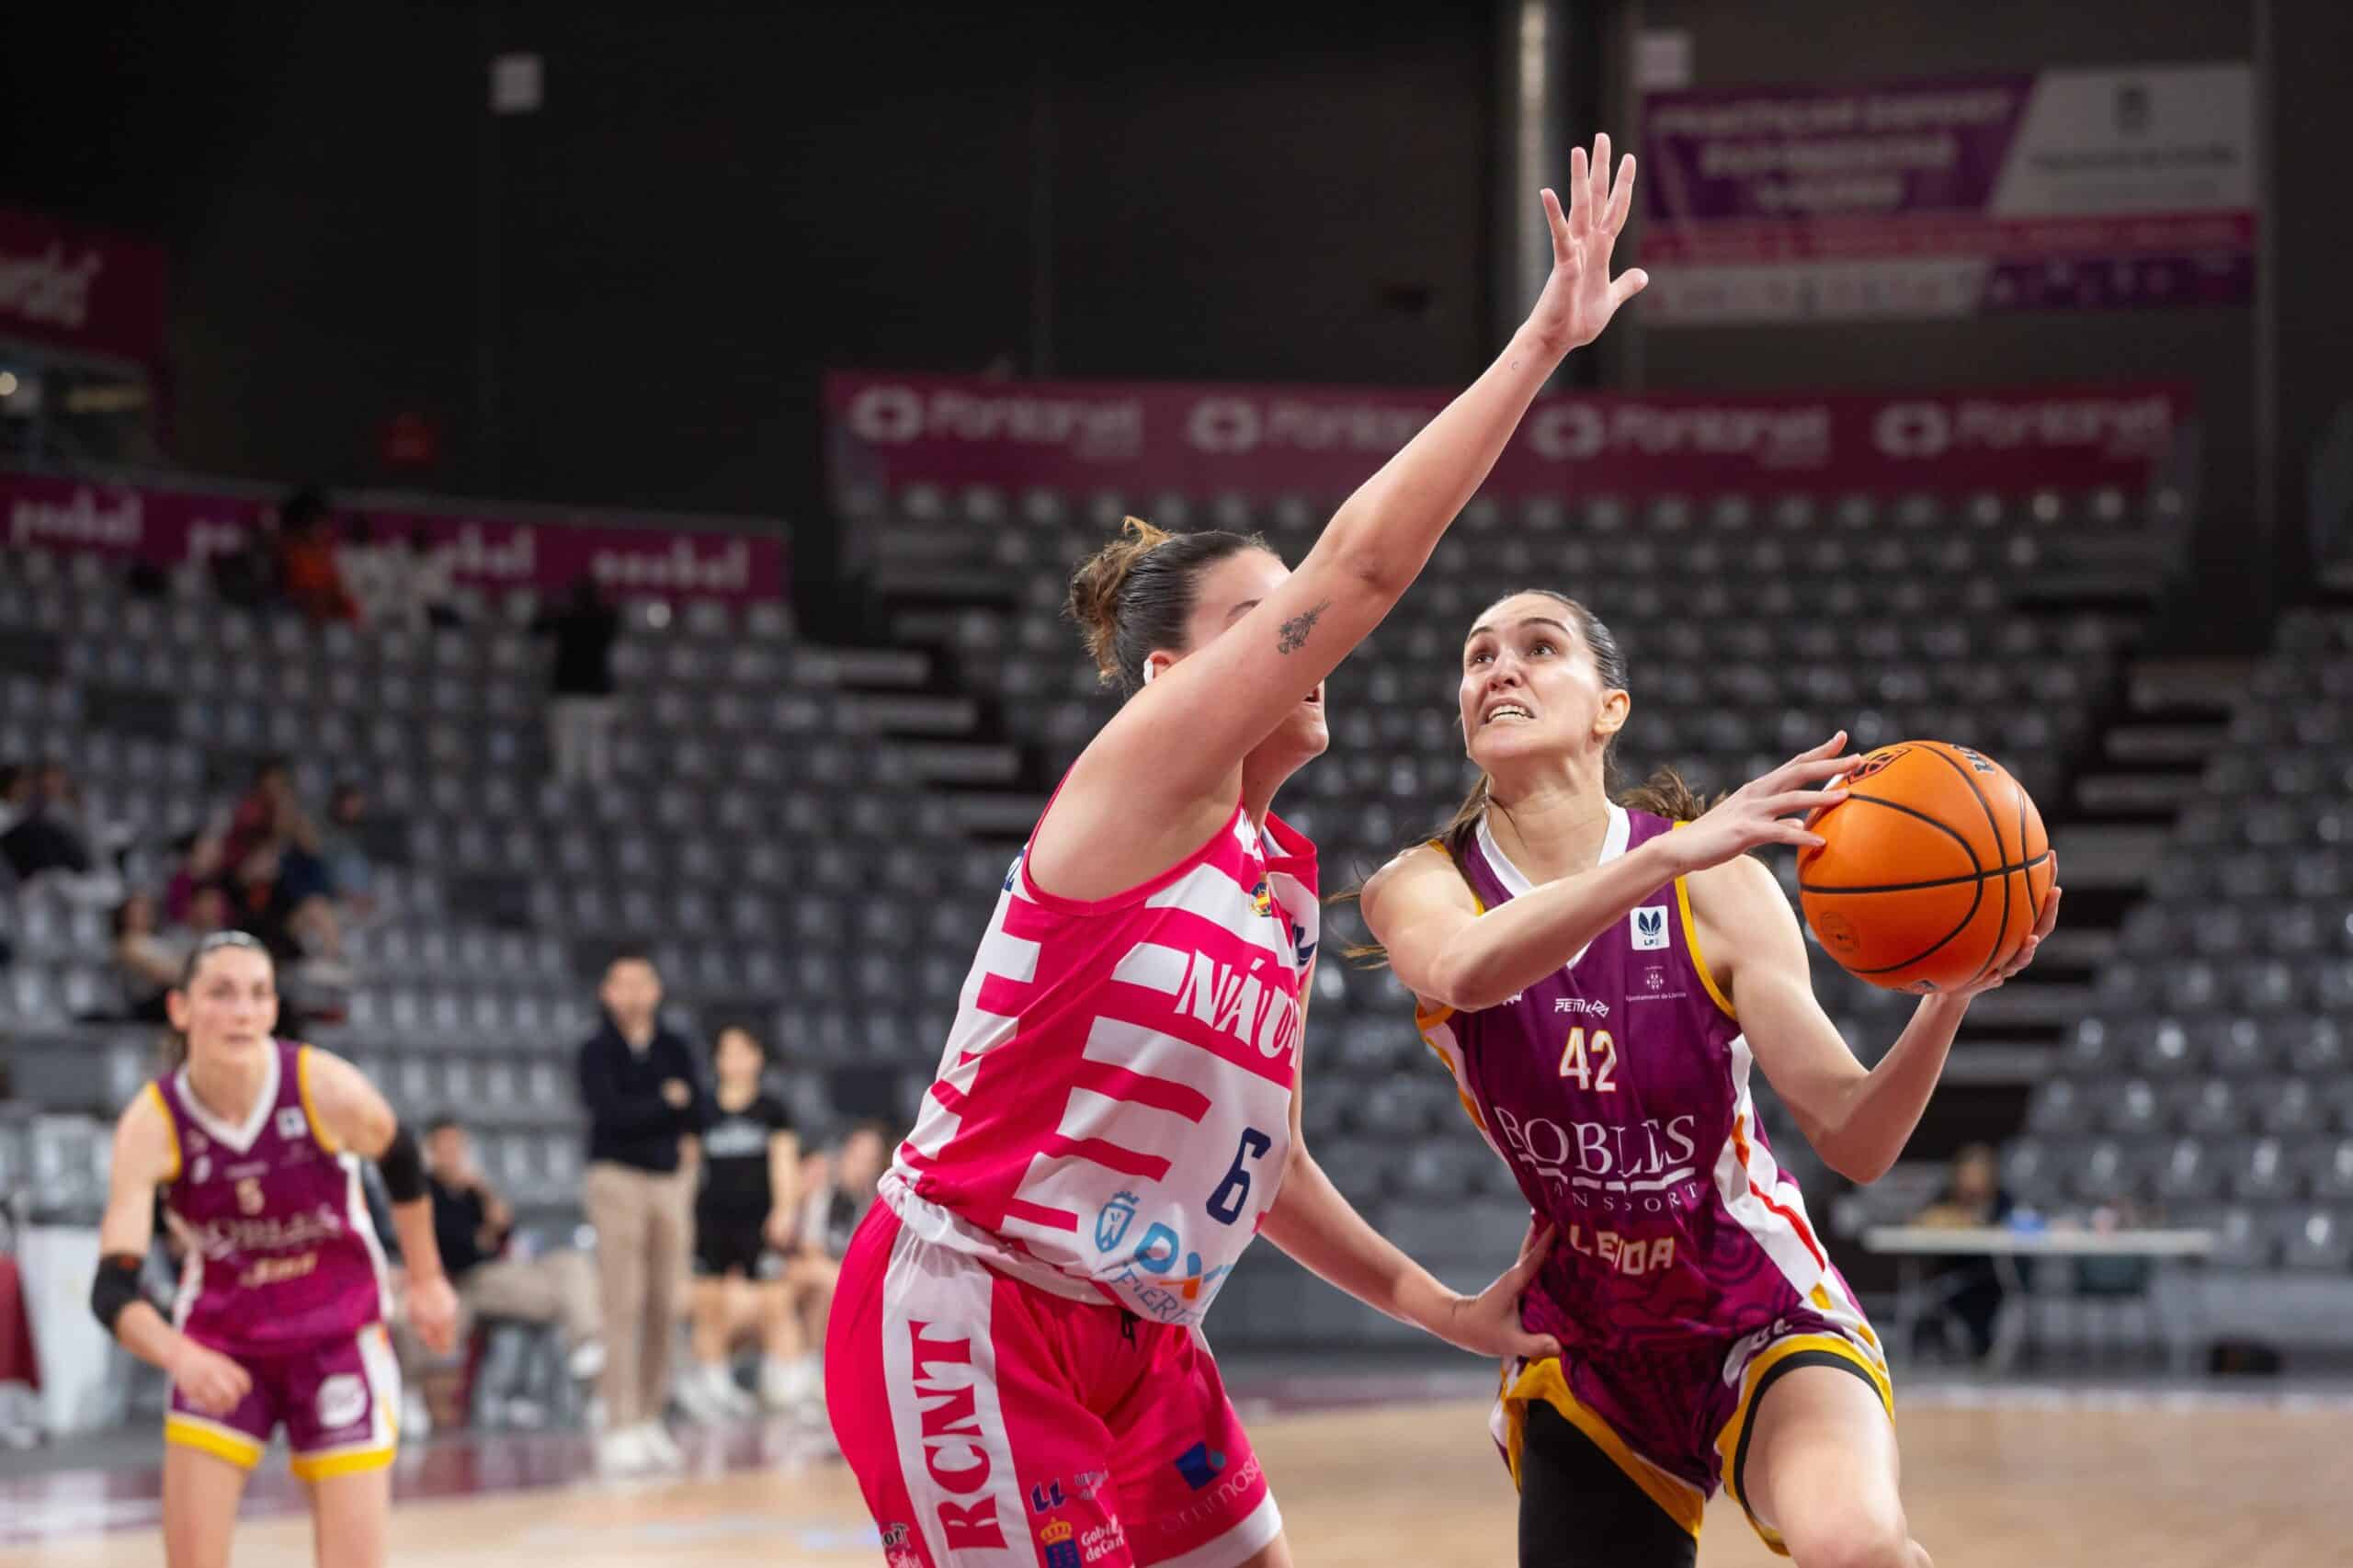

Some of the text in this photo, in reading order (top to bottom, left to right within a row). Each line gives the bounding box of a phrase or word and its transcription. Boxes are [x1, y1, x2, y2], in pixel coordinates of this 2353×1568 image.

[1559, 1027, 1618, 1092] 42
[1206, 1126, 1271, 1225] 6
[907, 1319, 1009, 1551] RCNT
